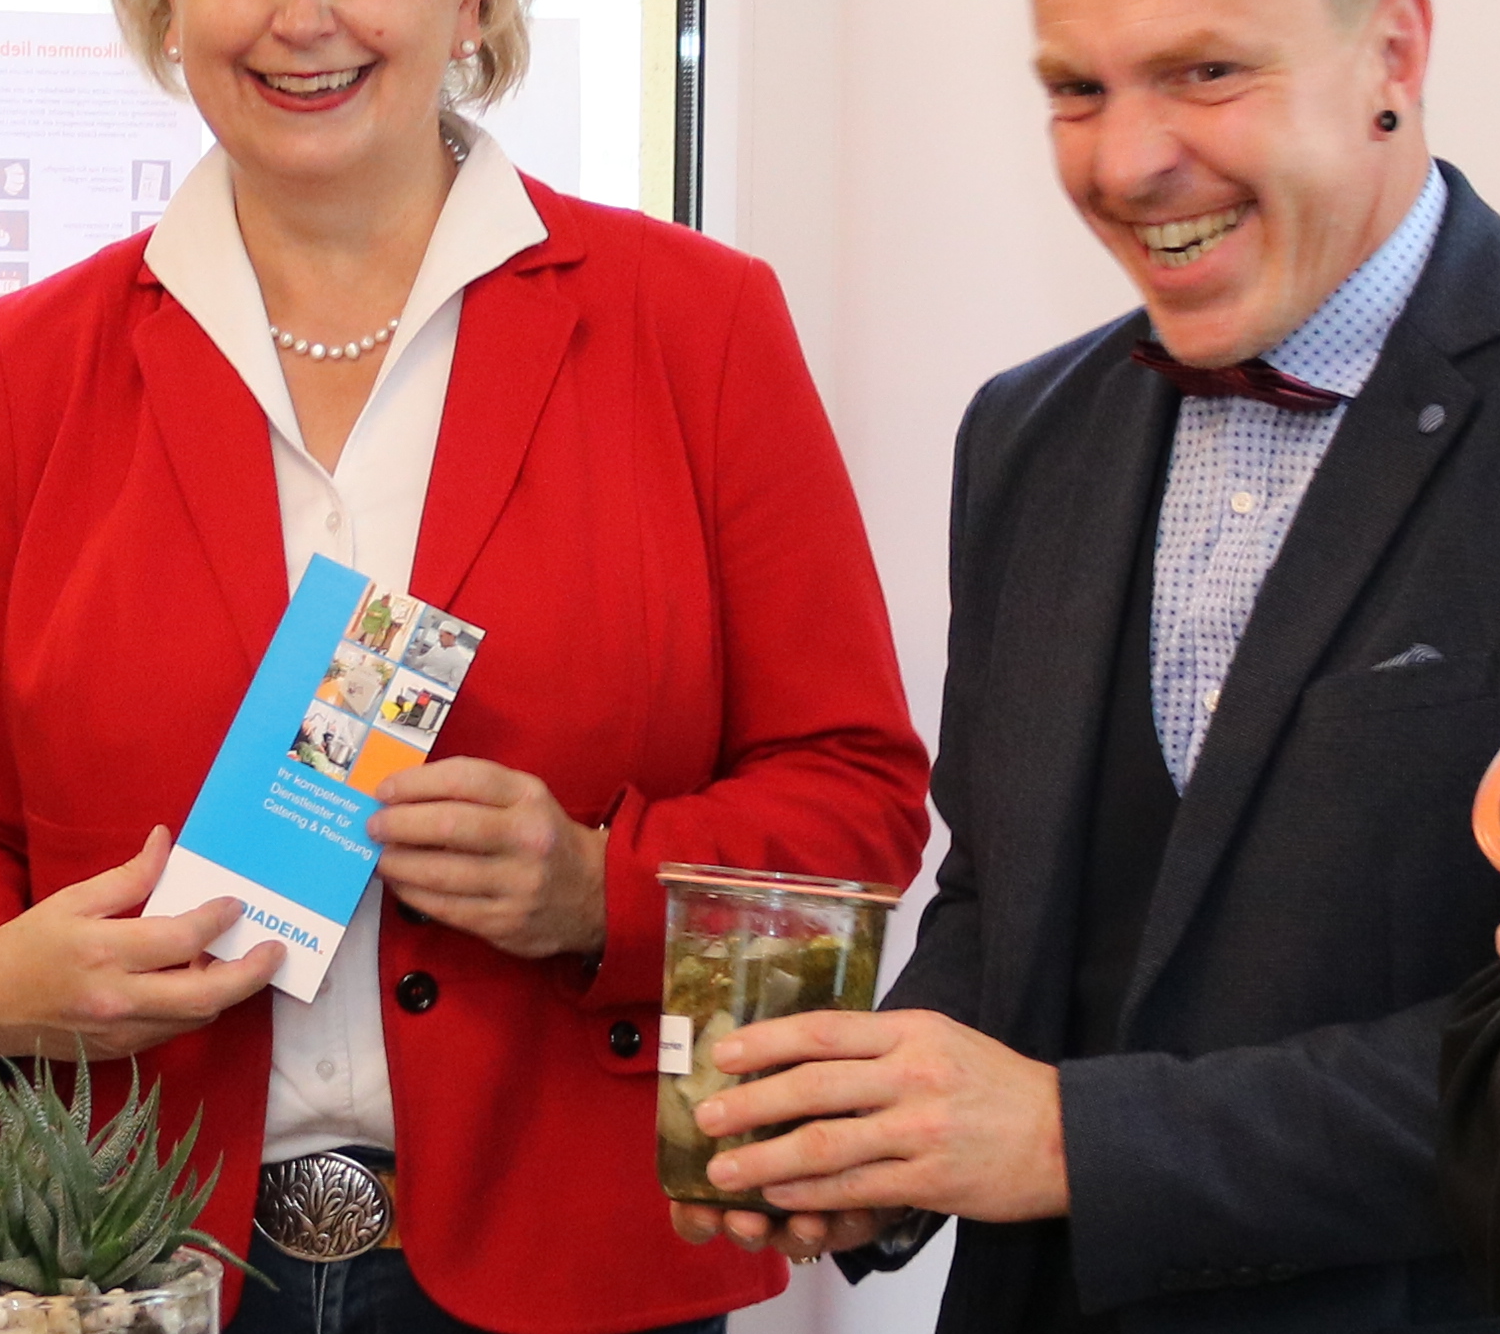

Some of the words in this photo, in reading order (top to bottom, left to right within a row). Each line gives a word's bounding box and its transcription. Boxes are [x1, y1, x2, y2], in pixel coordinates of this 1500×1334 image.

[269, 781, 336, 821] Dienstleister
[335, 813, 353, 829] für
[277, 766, 294, 781] Ihr
[293, 774, 361, 814] kompetenter
[262, 797, 309, 830] Catering
[309, 820, 319, 833] &
[319, 824, 374, 862] Reinigung
